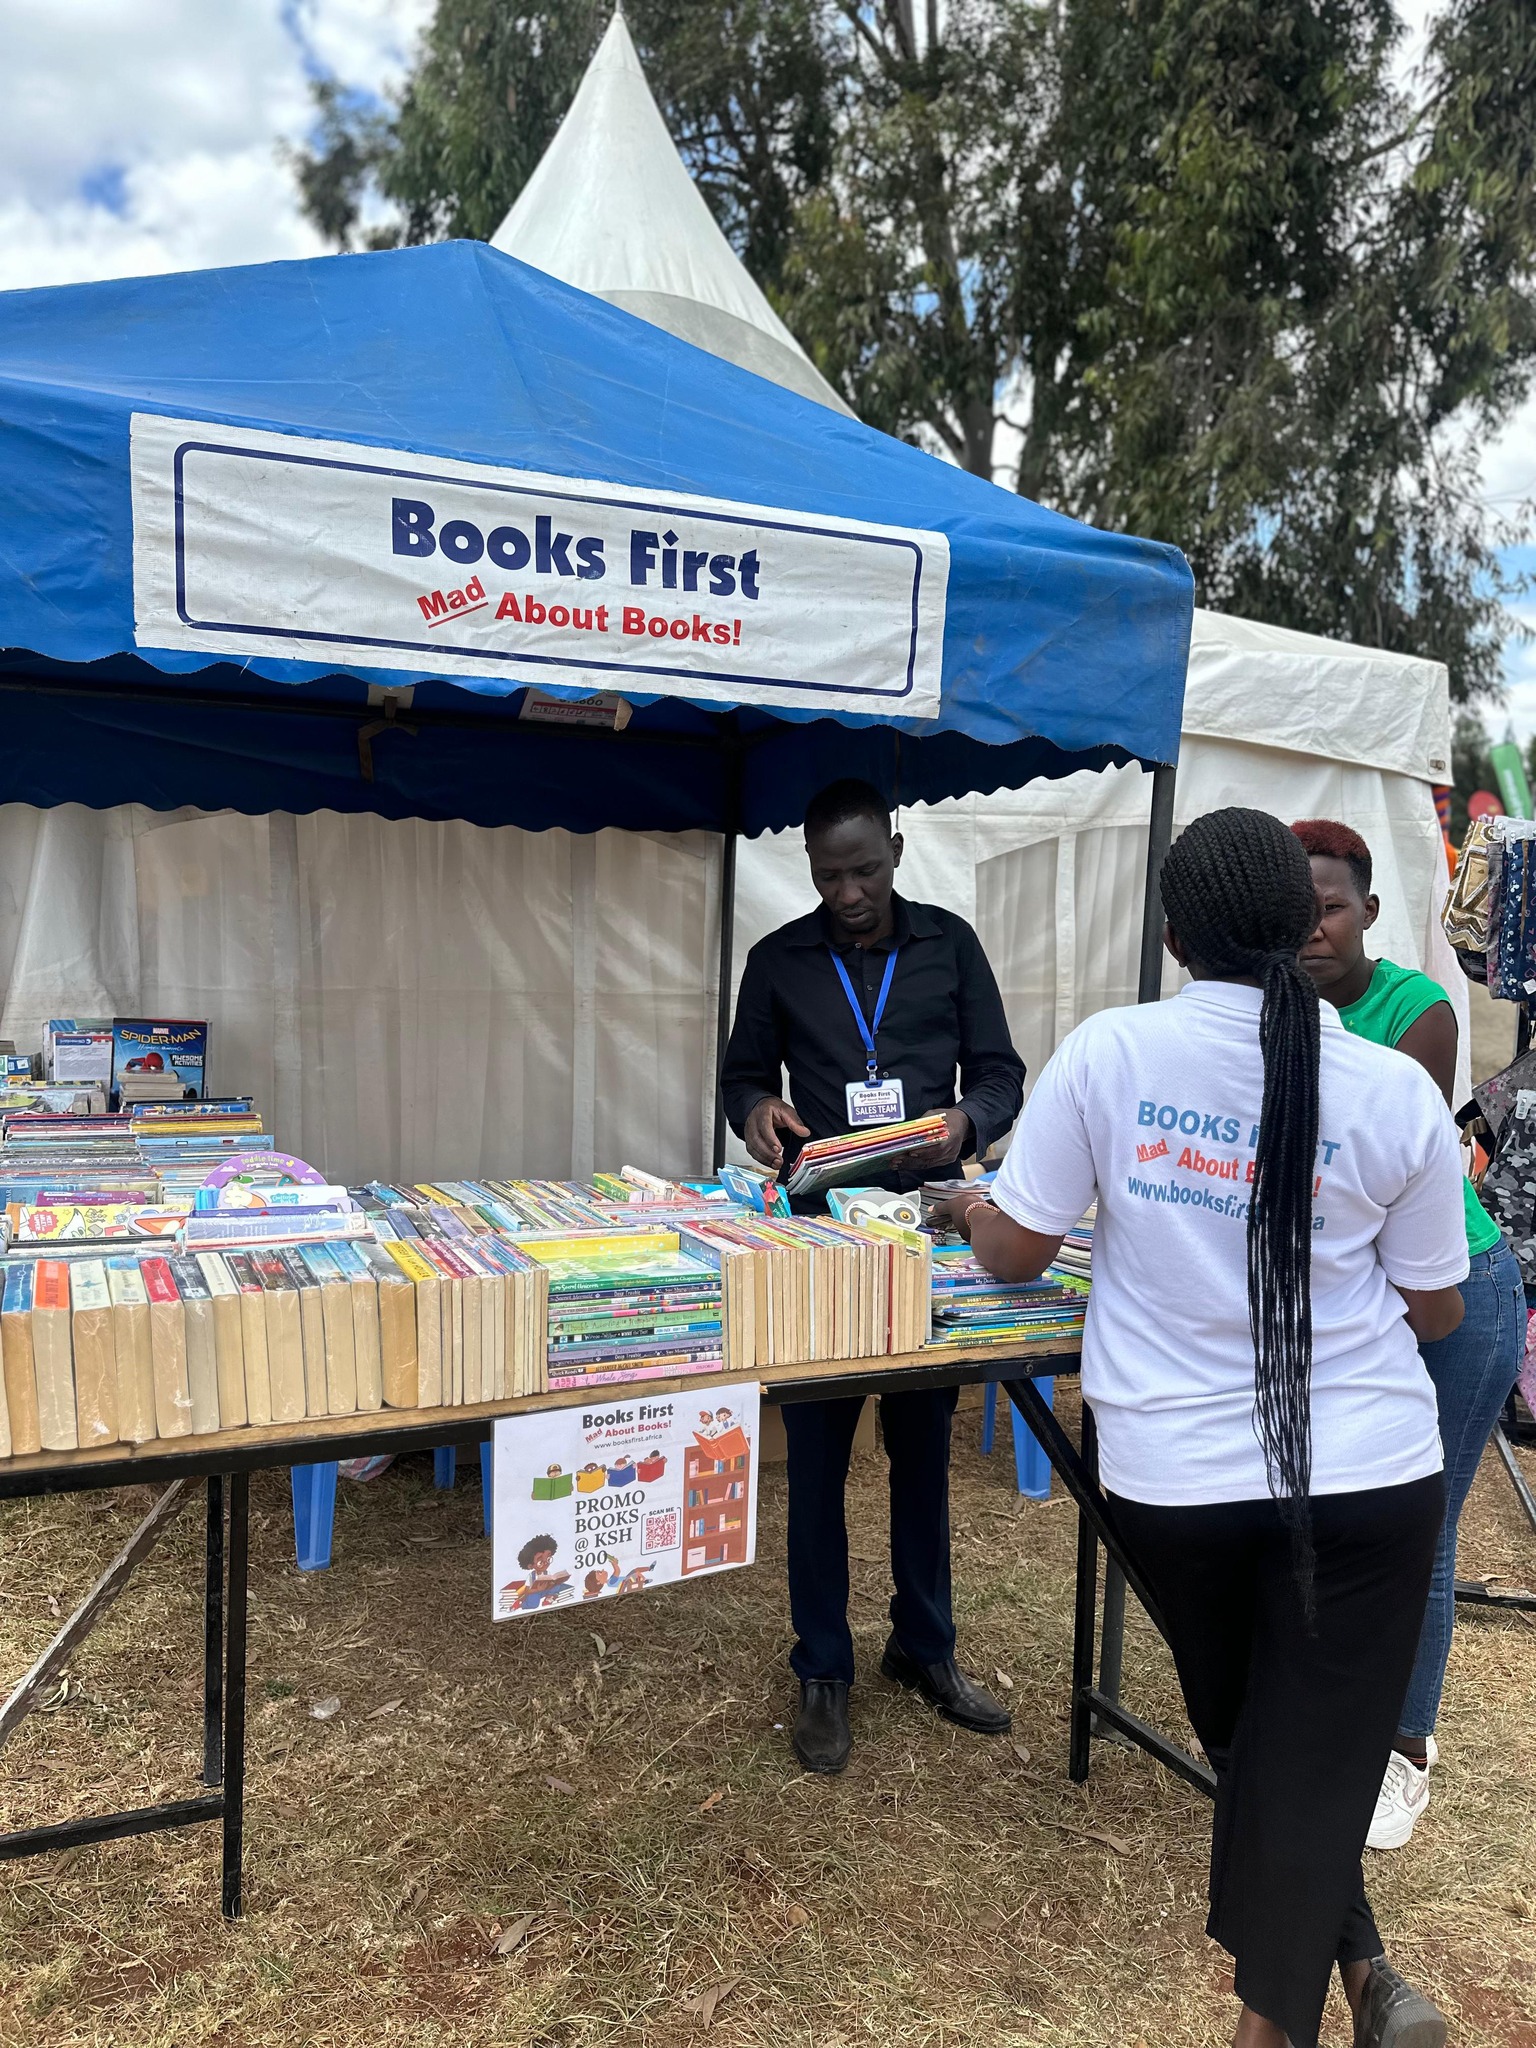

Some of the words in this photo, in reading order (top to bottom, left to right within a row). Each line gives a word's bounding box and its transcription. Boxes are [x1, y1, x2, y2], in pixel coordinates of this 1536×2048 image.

[392, 497, 606, 580] Books
[630, 529, 761, 600] First
[416, 575, 488, 624] Mad
[494, 592, 609, 632] About
[622, 605, 743, 646] Books!
[120, 1029, 202, 1045] SPIDER-MAN
[855, 1106, 877, 1115] SALES
[877, 1104, 897, 1113] TEAM
[1137, 1100, 1241, 1144] BOOKS
[1135, 1138, 1170, 1163] Mad
[1176, 1147, 1239, 1181] About
[614, 1346, 639, 1354] Princess
[582, 1409, 634, 1429] Books
[639, 1403, 674, 1420] First
[585, 1428, 603, 1442] Mad
[605, 1426, 635, 1438] About
[637, 1419, 672, 1432] Books!
[594, 1434, 663, 1449] www.booksfirst.africa
[575, 1490, 645, 1516] PROMO
[648, 1508, 665, 1517] SCAN
[575, 1508, 639, 1534] BOOKS
[574, 1537, 589, 1553] @
[594, 1527, 633, 1548] KSH
[574, 1550, 608, 1570] 300
